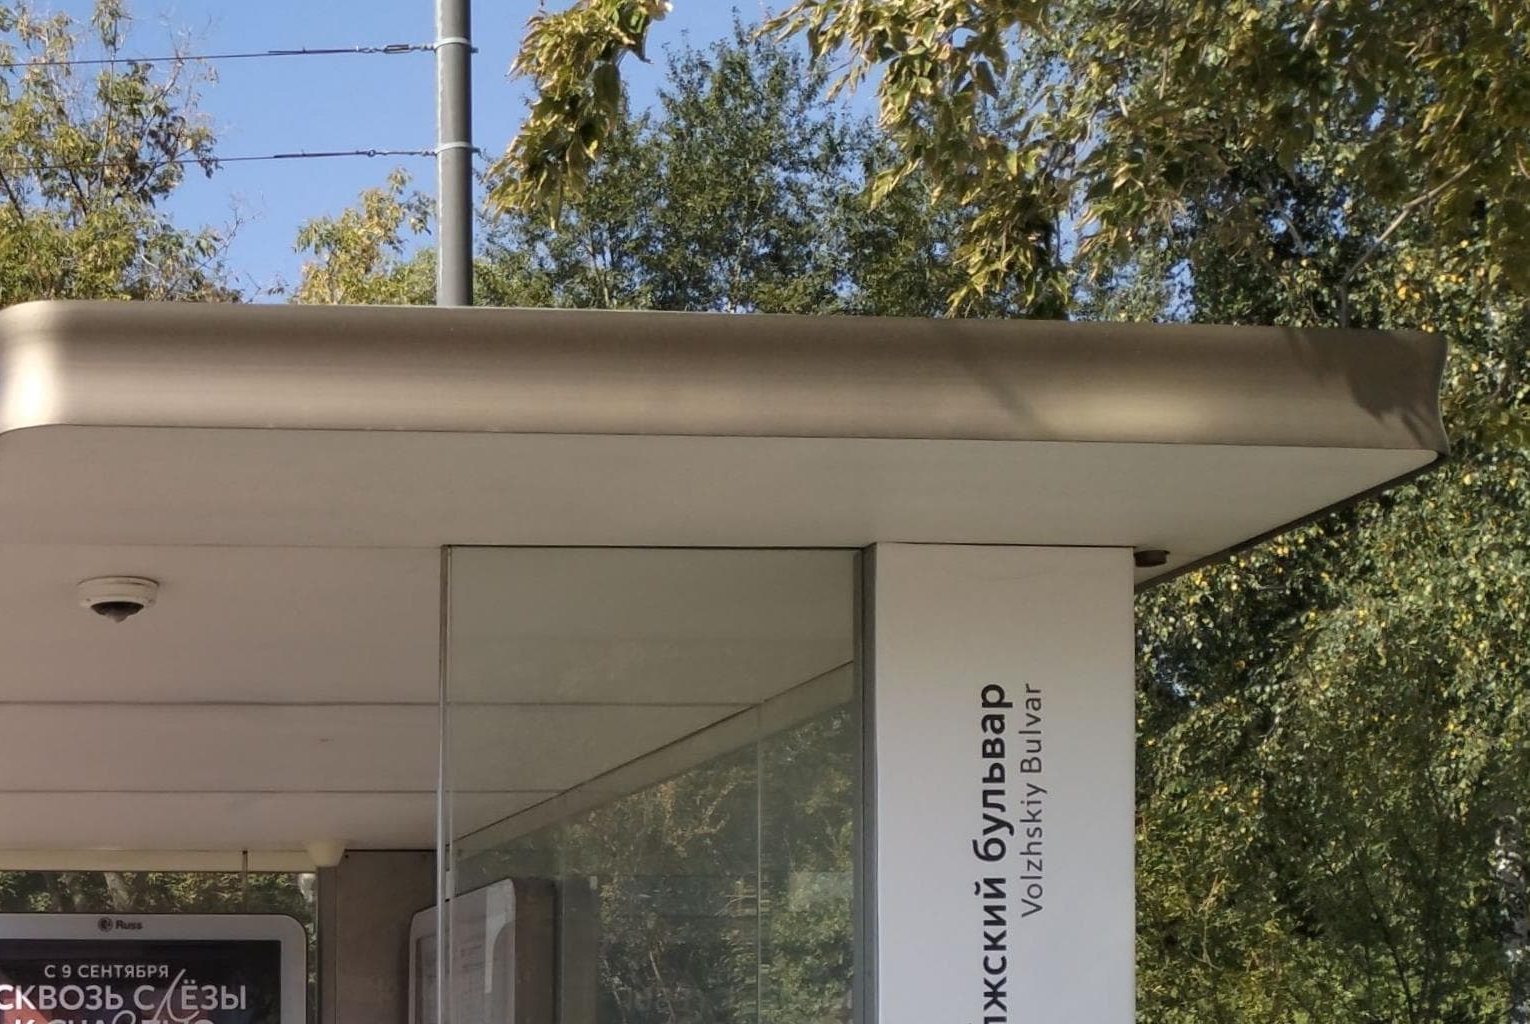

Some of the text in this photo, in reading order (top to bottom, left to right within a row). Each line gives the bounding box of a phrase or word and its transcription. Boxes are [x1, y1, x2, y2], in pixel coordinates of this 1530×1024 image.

[971, 682, 1014, 862] бульвар
[1018, 682, 1048, 918] Volzhskiy Bulvar
[115, 919, 143, 930] Russ
[44, 964, 169, 979] С 9 СЕНТЯБРЯ
[133, 971, 247, 1018] СЛЁЗЫ
